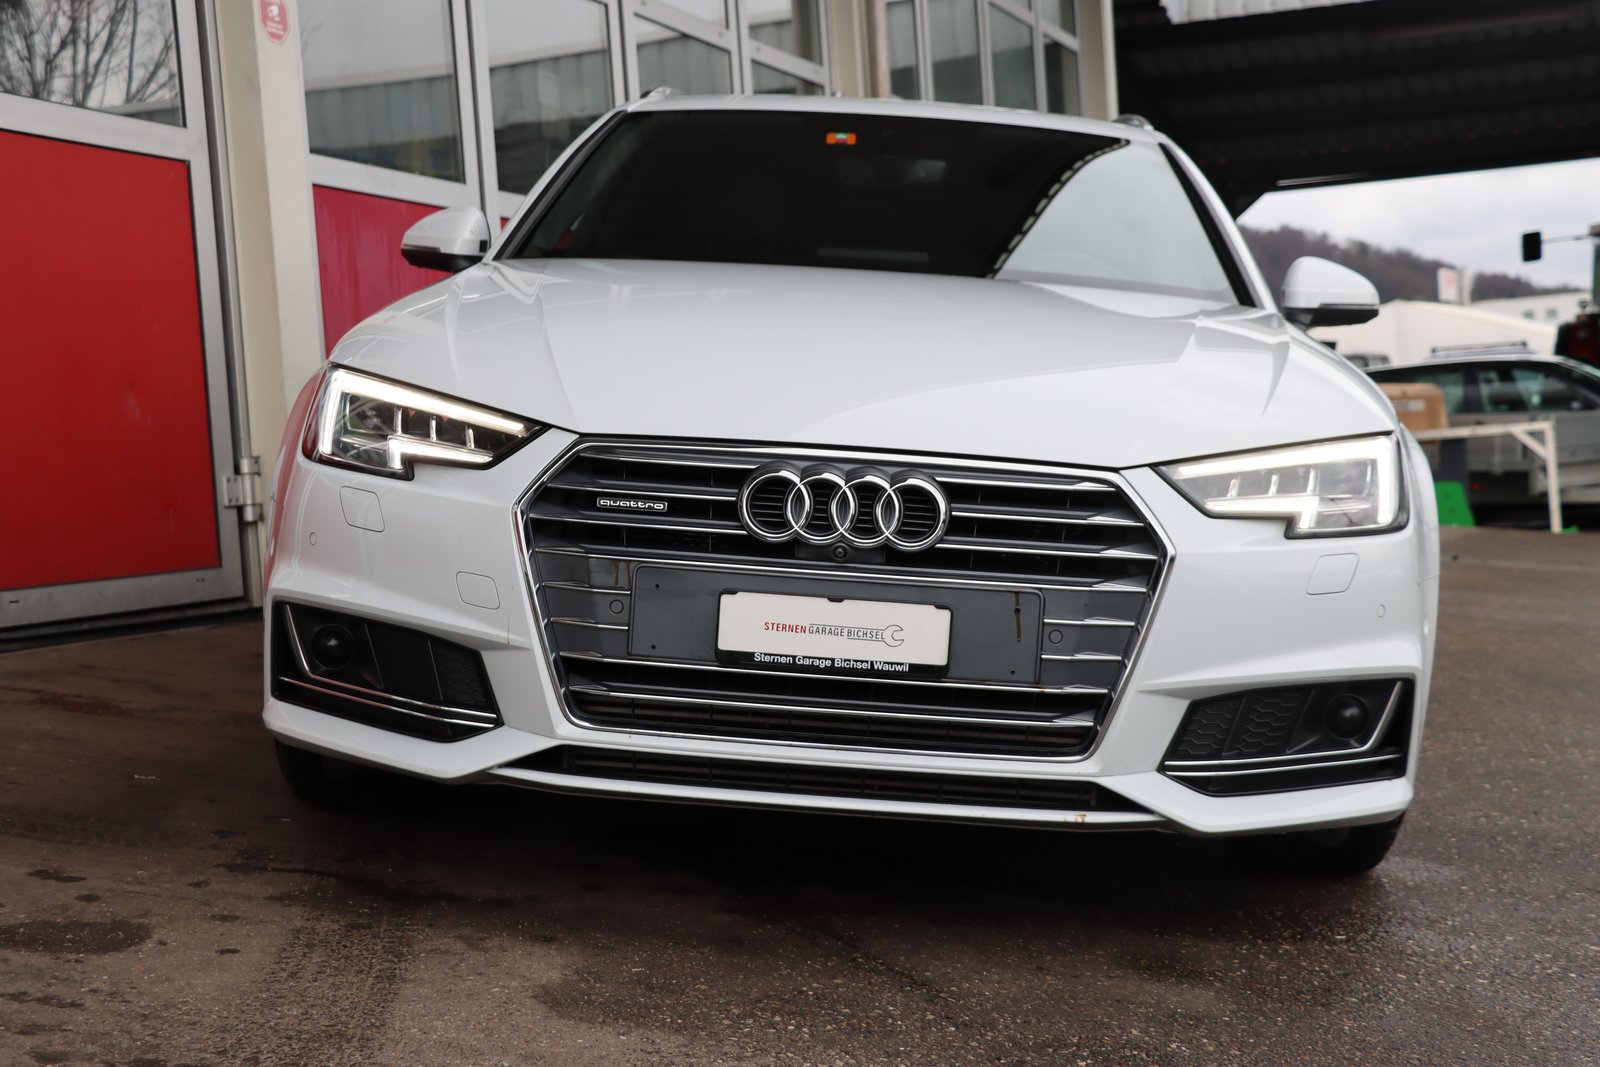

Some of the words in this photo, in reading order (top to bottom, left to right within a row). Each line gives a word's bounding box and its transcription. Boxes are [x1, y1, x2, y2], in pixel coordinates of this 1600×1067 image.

[600, 499, 664, 509] quattro
[764, 621, 807, 634] STERNEN
[809, 626, 845, 637] GARAGE
[847, 629, 885, 640] BICHSEL
[754, 652, 793, 664] Sternen
[795, 655, 832, 668] Garage
[834, 658, 871, 670] Bichsel
[873, 661, 909, 672] Wauwil
